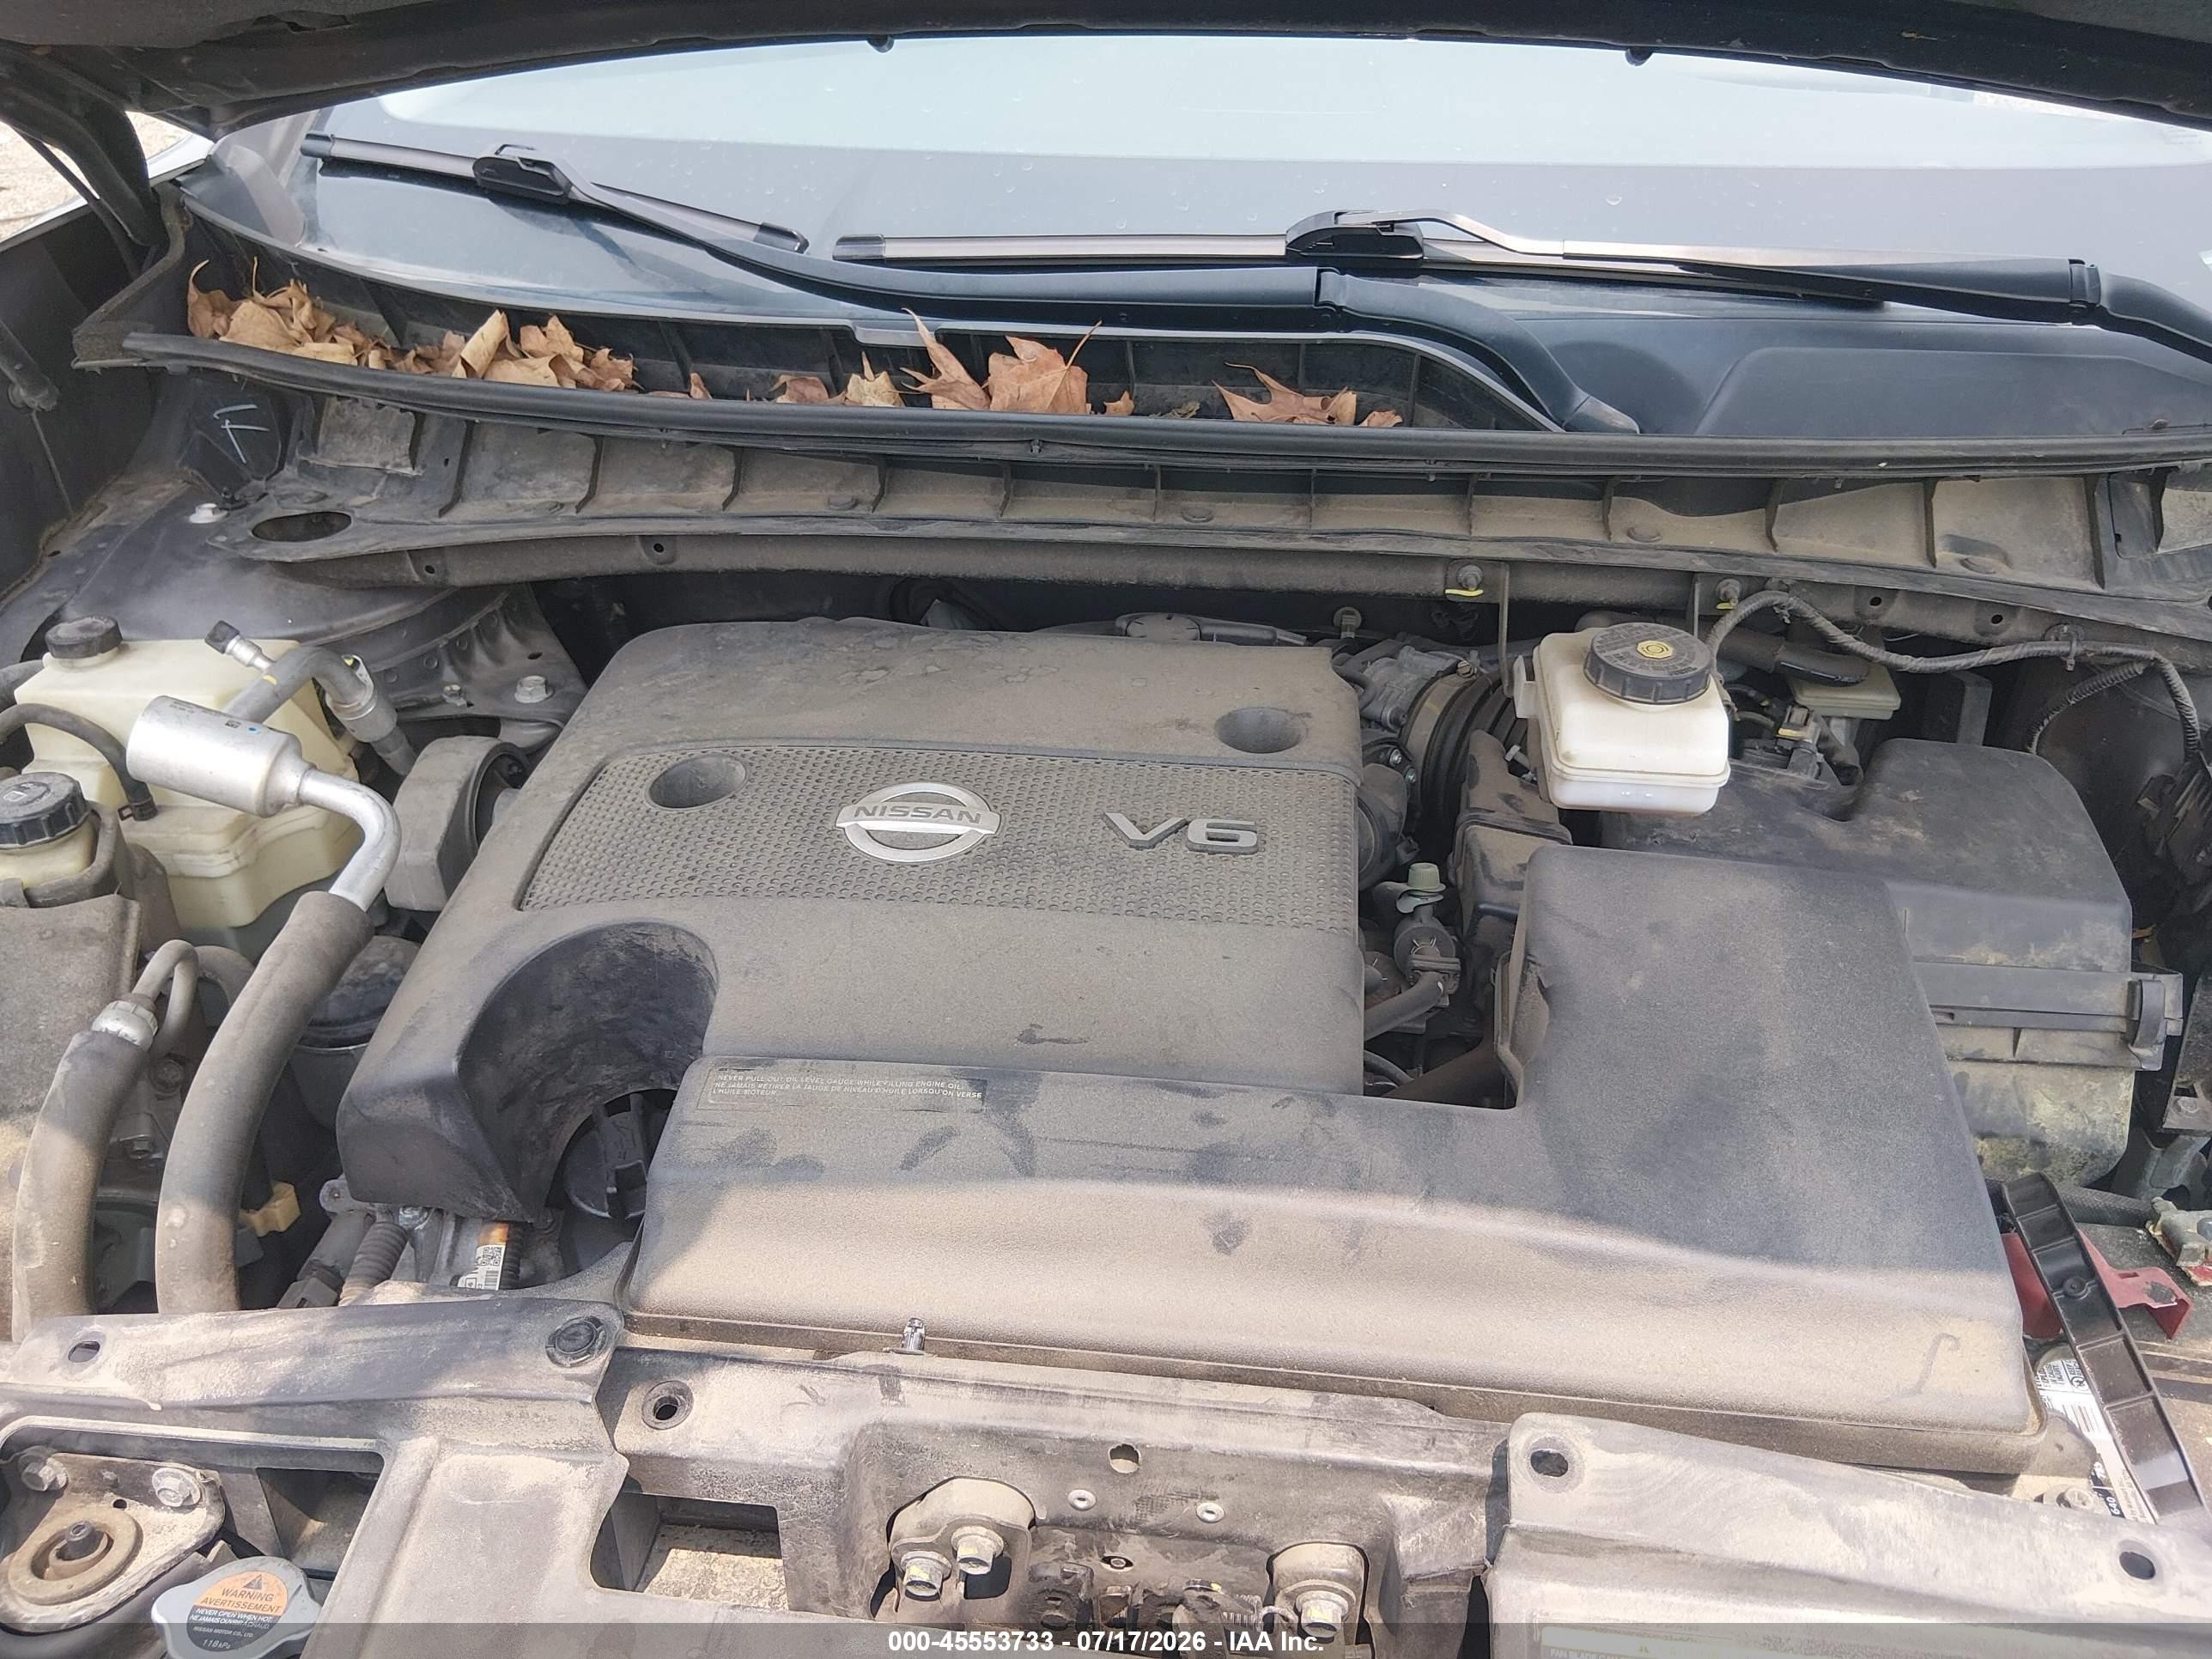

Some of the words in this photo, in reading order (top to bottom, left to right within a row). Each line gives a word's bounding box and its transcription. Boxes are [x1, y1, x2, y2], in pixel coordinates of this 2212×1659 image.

[854, 804, 982, 825] NISSAN
[1102, 811, 1258, 855] V6
[915, 1080, 946, 1089] ENGINE
[908, 1088, 953, 1097] LORSQU'ON
[2106, 1497, 2121, 1516] 640
[222, 1587, 274, 1602] WARNING
[200, 1597, 282, 1613] AVERTISSEMENT
[237, 1613, 257, 1621] WHEN
